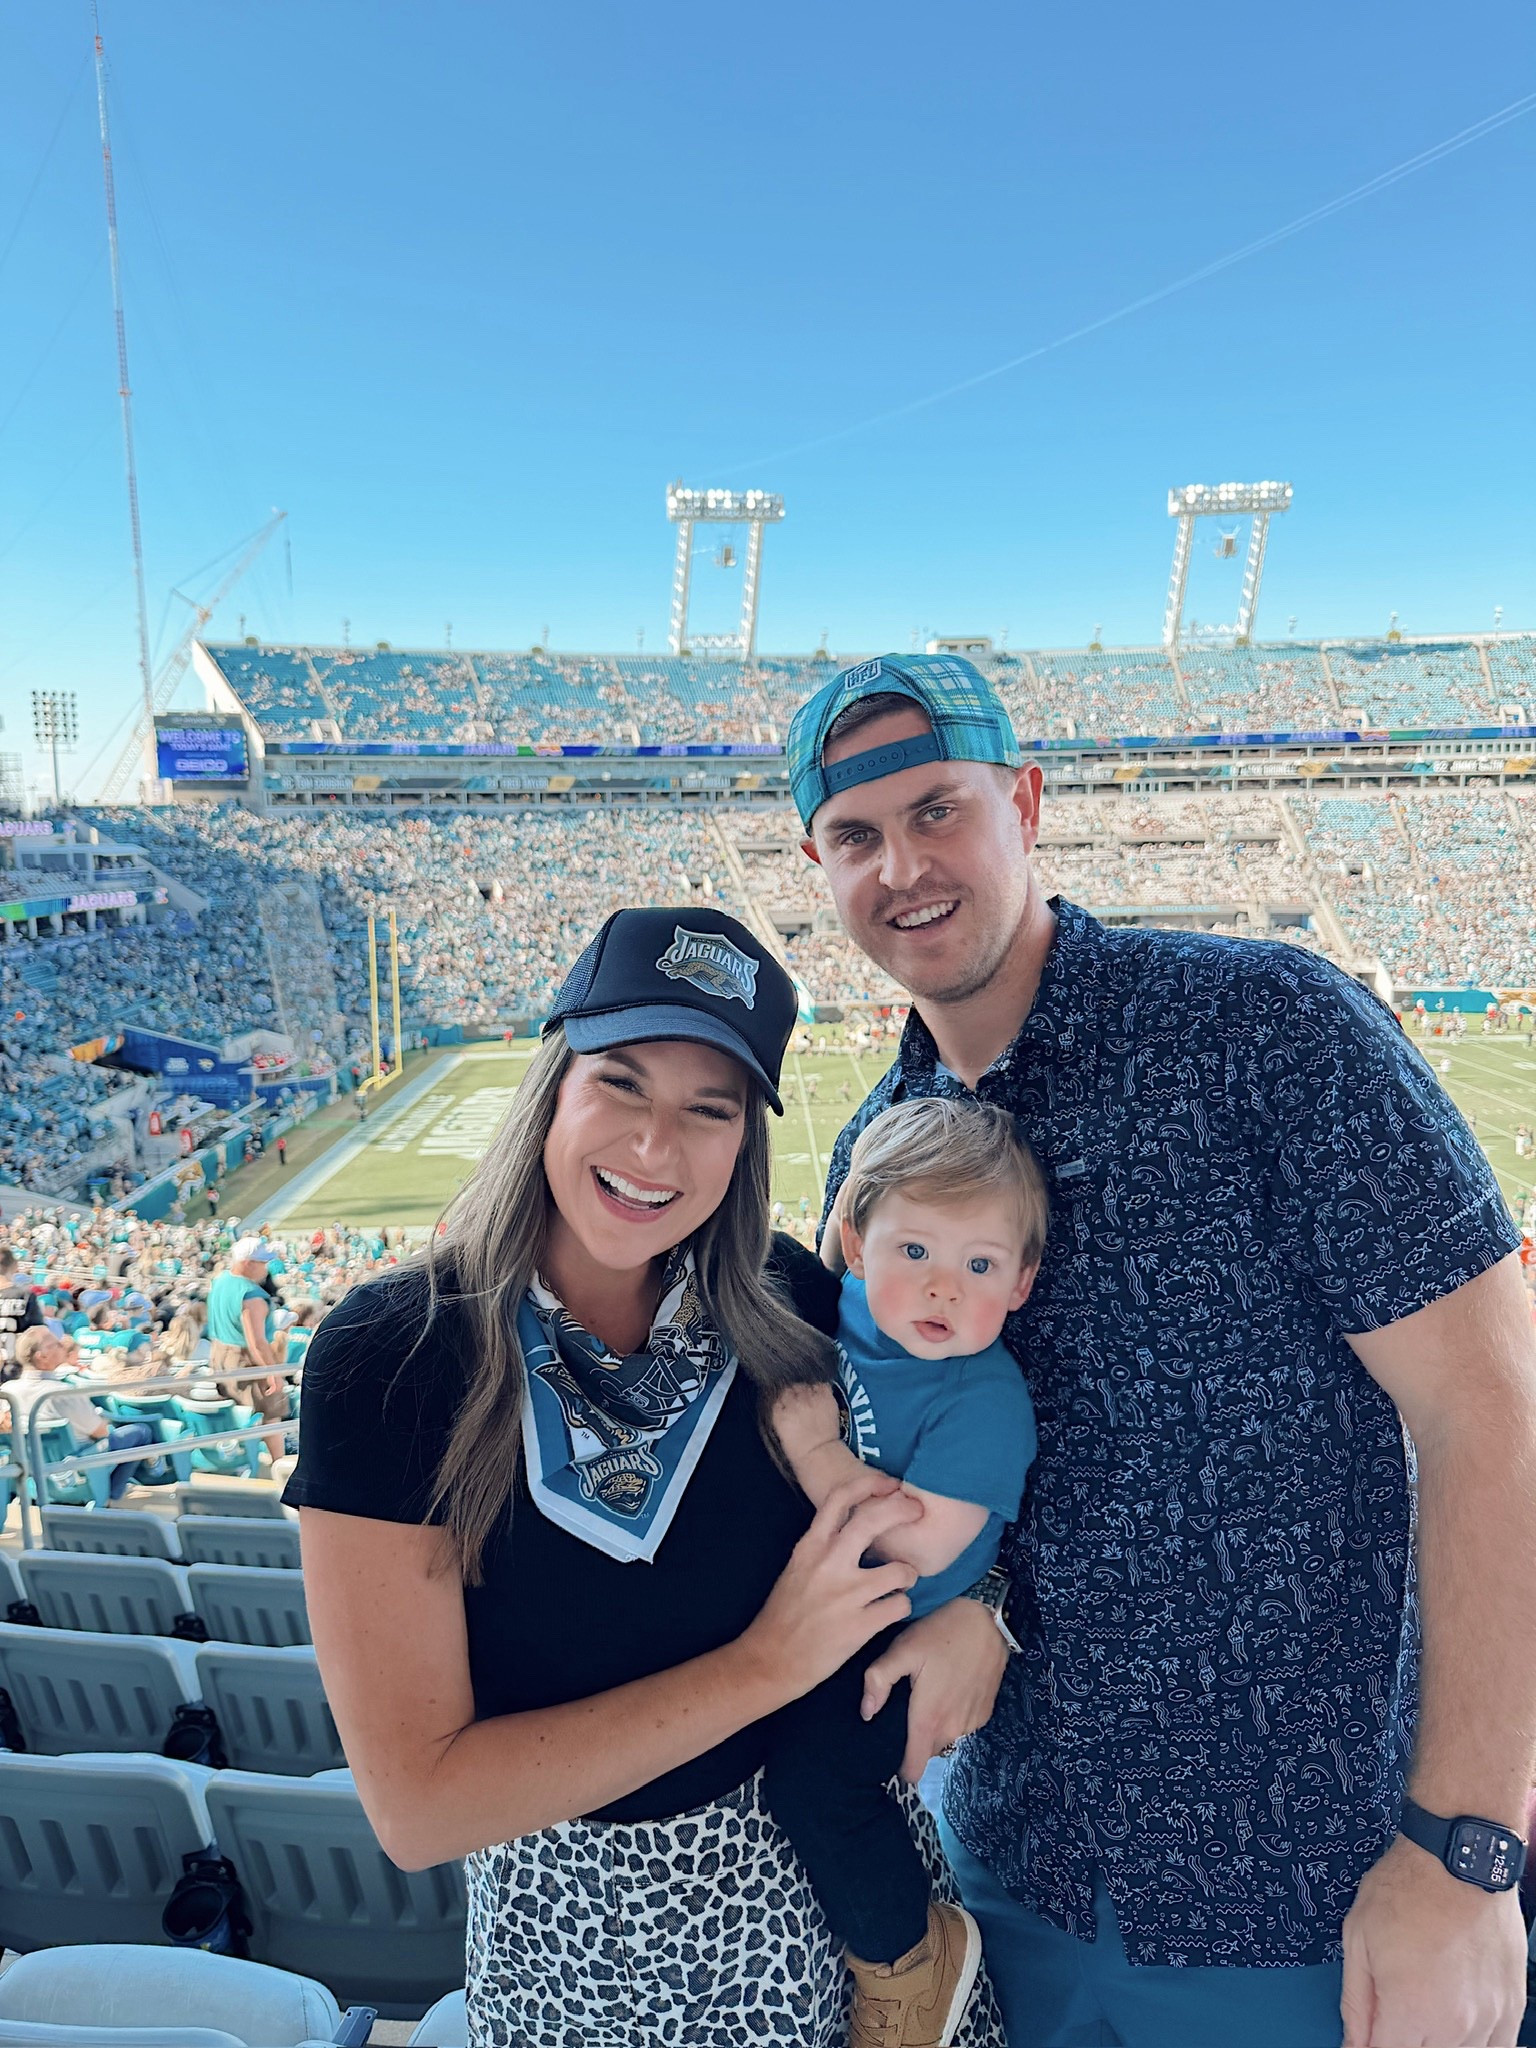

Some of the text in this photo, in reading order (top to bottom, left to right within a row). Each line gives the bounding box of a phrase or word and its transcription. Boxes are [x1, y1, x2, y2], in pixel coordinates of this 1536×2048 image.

[159, 729, 221, 743] WELCOME
[175, 759, 228, 772] GEICO
[70, 891, 137, 911] JAGUARS
[671, 935, 754, 993] JAGUARS
[579, 1443, 659, 1498] JAGUARS
